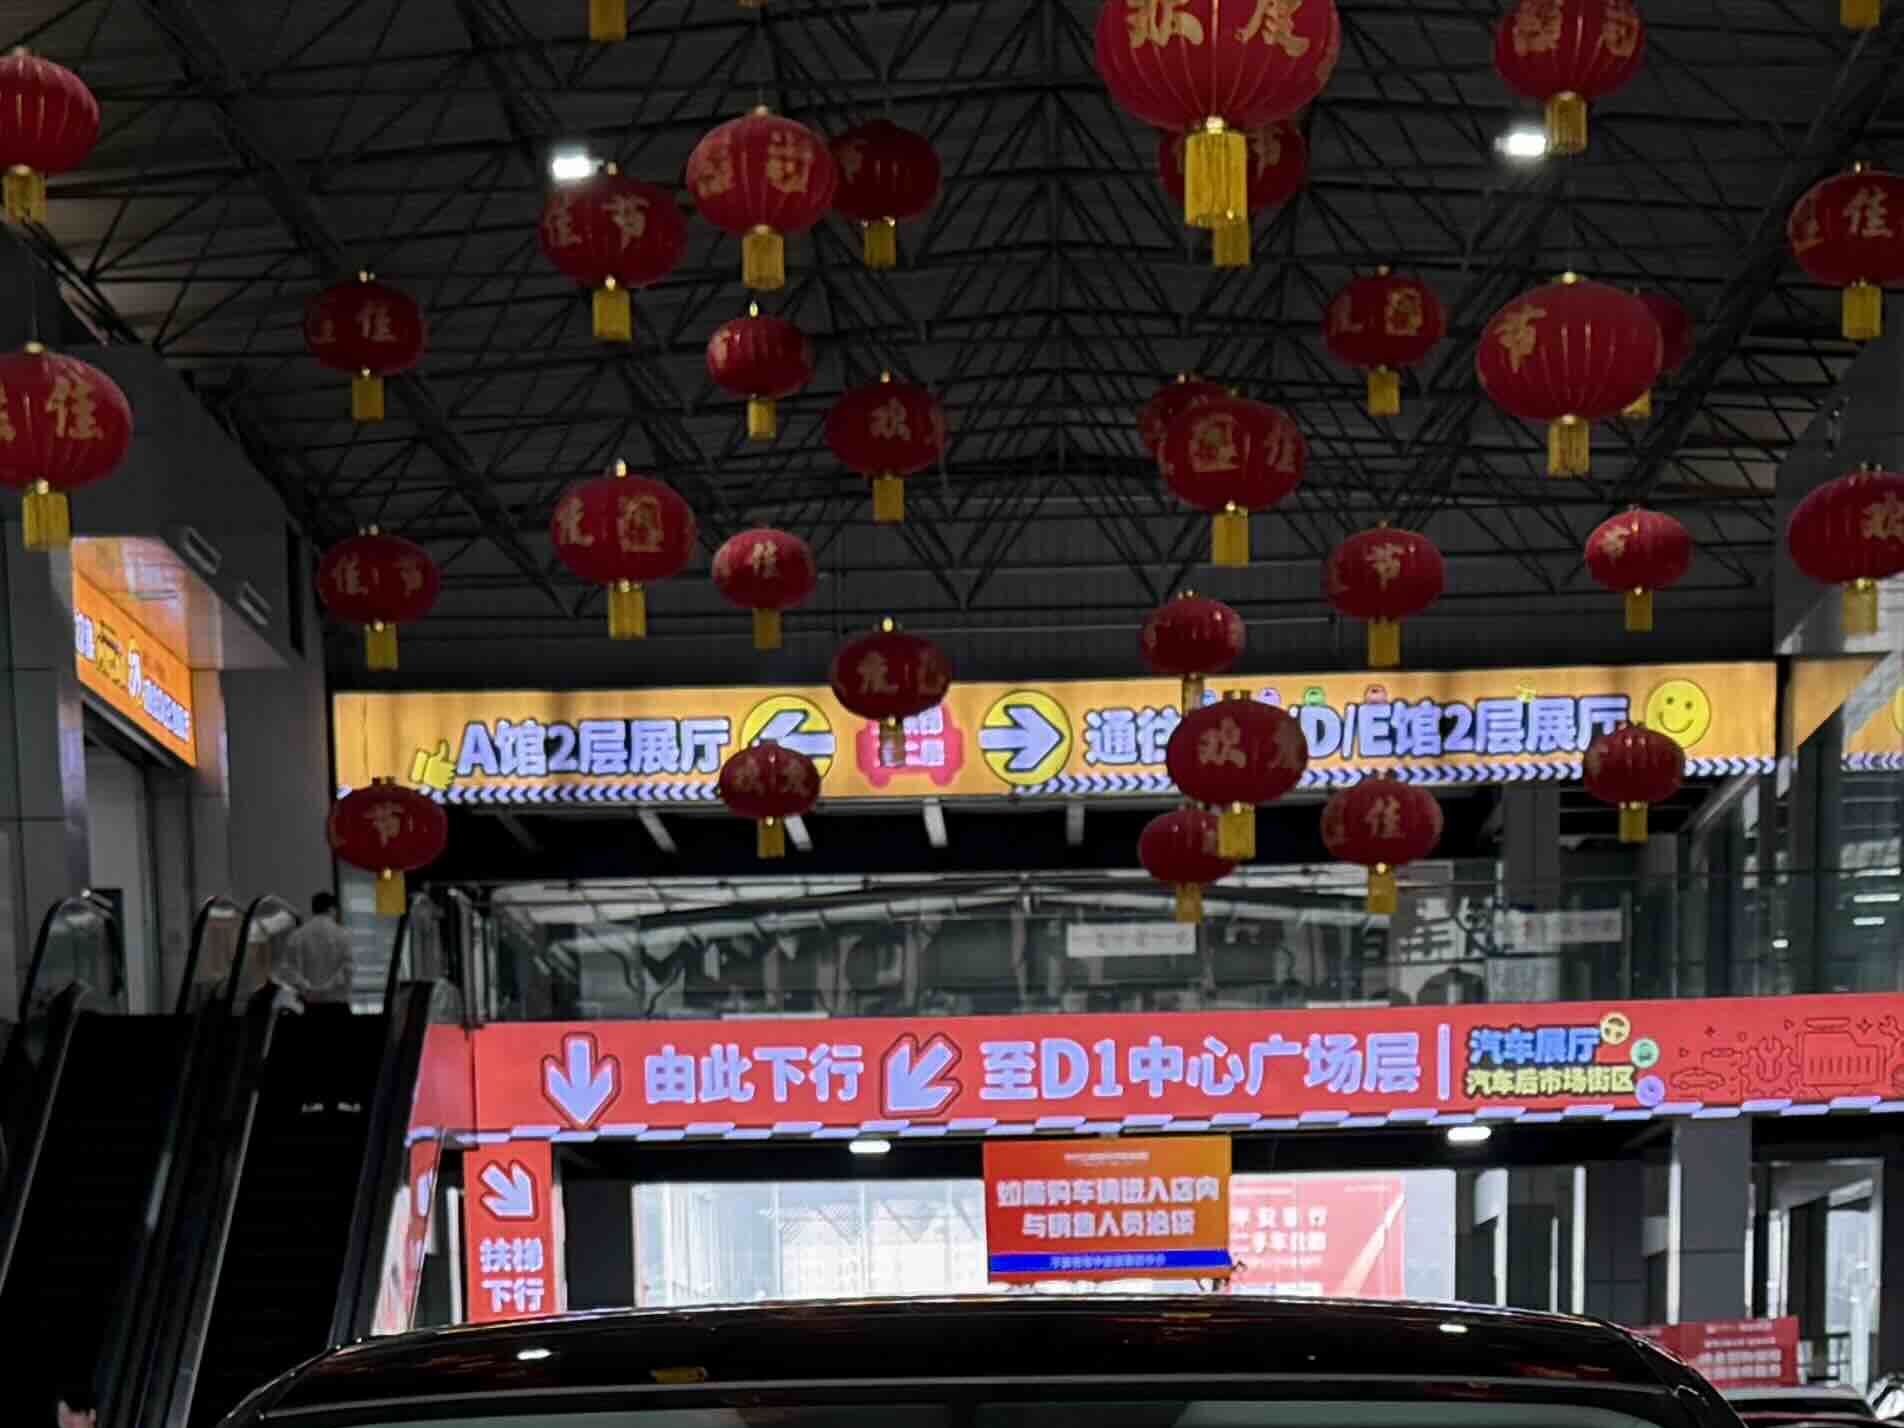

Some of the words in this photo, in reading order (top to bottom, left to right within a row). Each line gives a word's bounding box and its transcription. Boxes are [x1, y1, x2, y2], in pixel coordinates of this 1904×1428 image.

[457, 719, 730, 777] A馆2层展厅
[979, 1031, 1421, 1102] 至D1中心广场层
[1468, 1026, 1601, 1066] 汽车展厅
[644, 1043, 865, 1104] 由此下行
[1465, 1064, 1636, 1097] 汽车后市场街区
[480, 1277, 545, 1313] 下行
